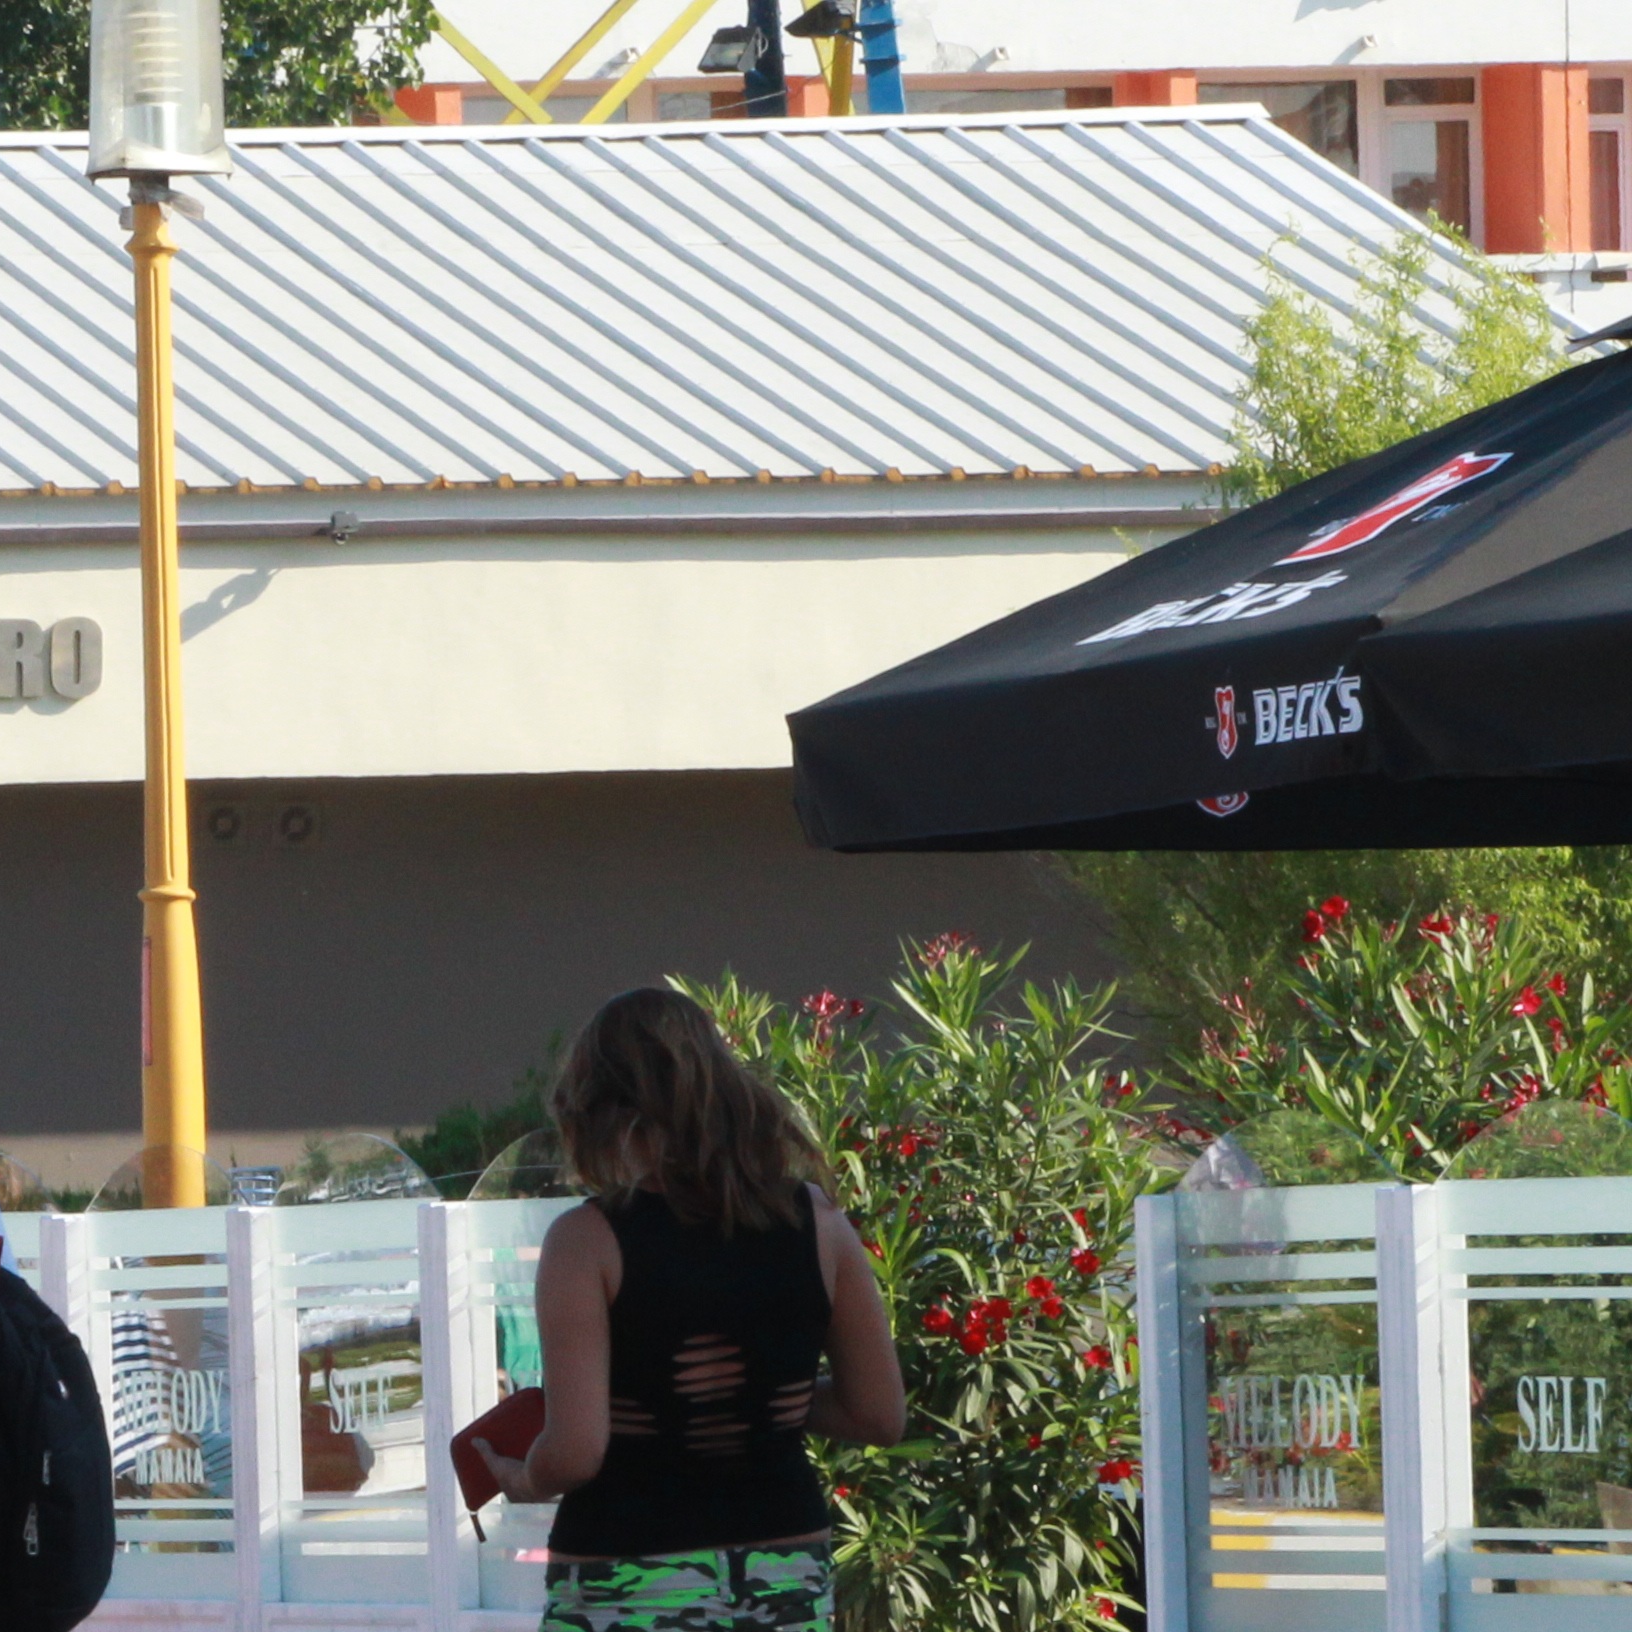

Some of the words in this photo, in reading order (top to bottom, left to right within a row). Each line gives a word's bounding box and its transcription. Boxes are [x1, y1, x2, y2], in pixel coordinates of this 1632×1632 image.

[1253, 665, 1364, 745] BECK'S
[1217, 1373, 1366, 1451] MELODY
[1516, 1375, 1607, 1454] SELF
[135, 1448, 205, 1485] MAMAIA
[1243, 1465, 1338, 1509] MAMAIA
